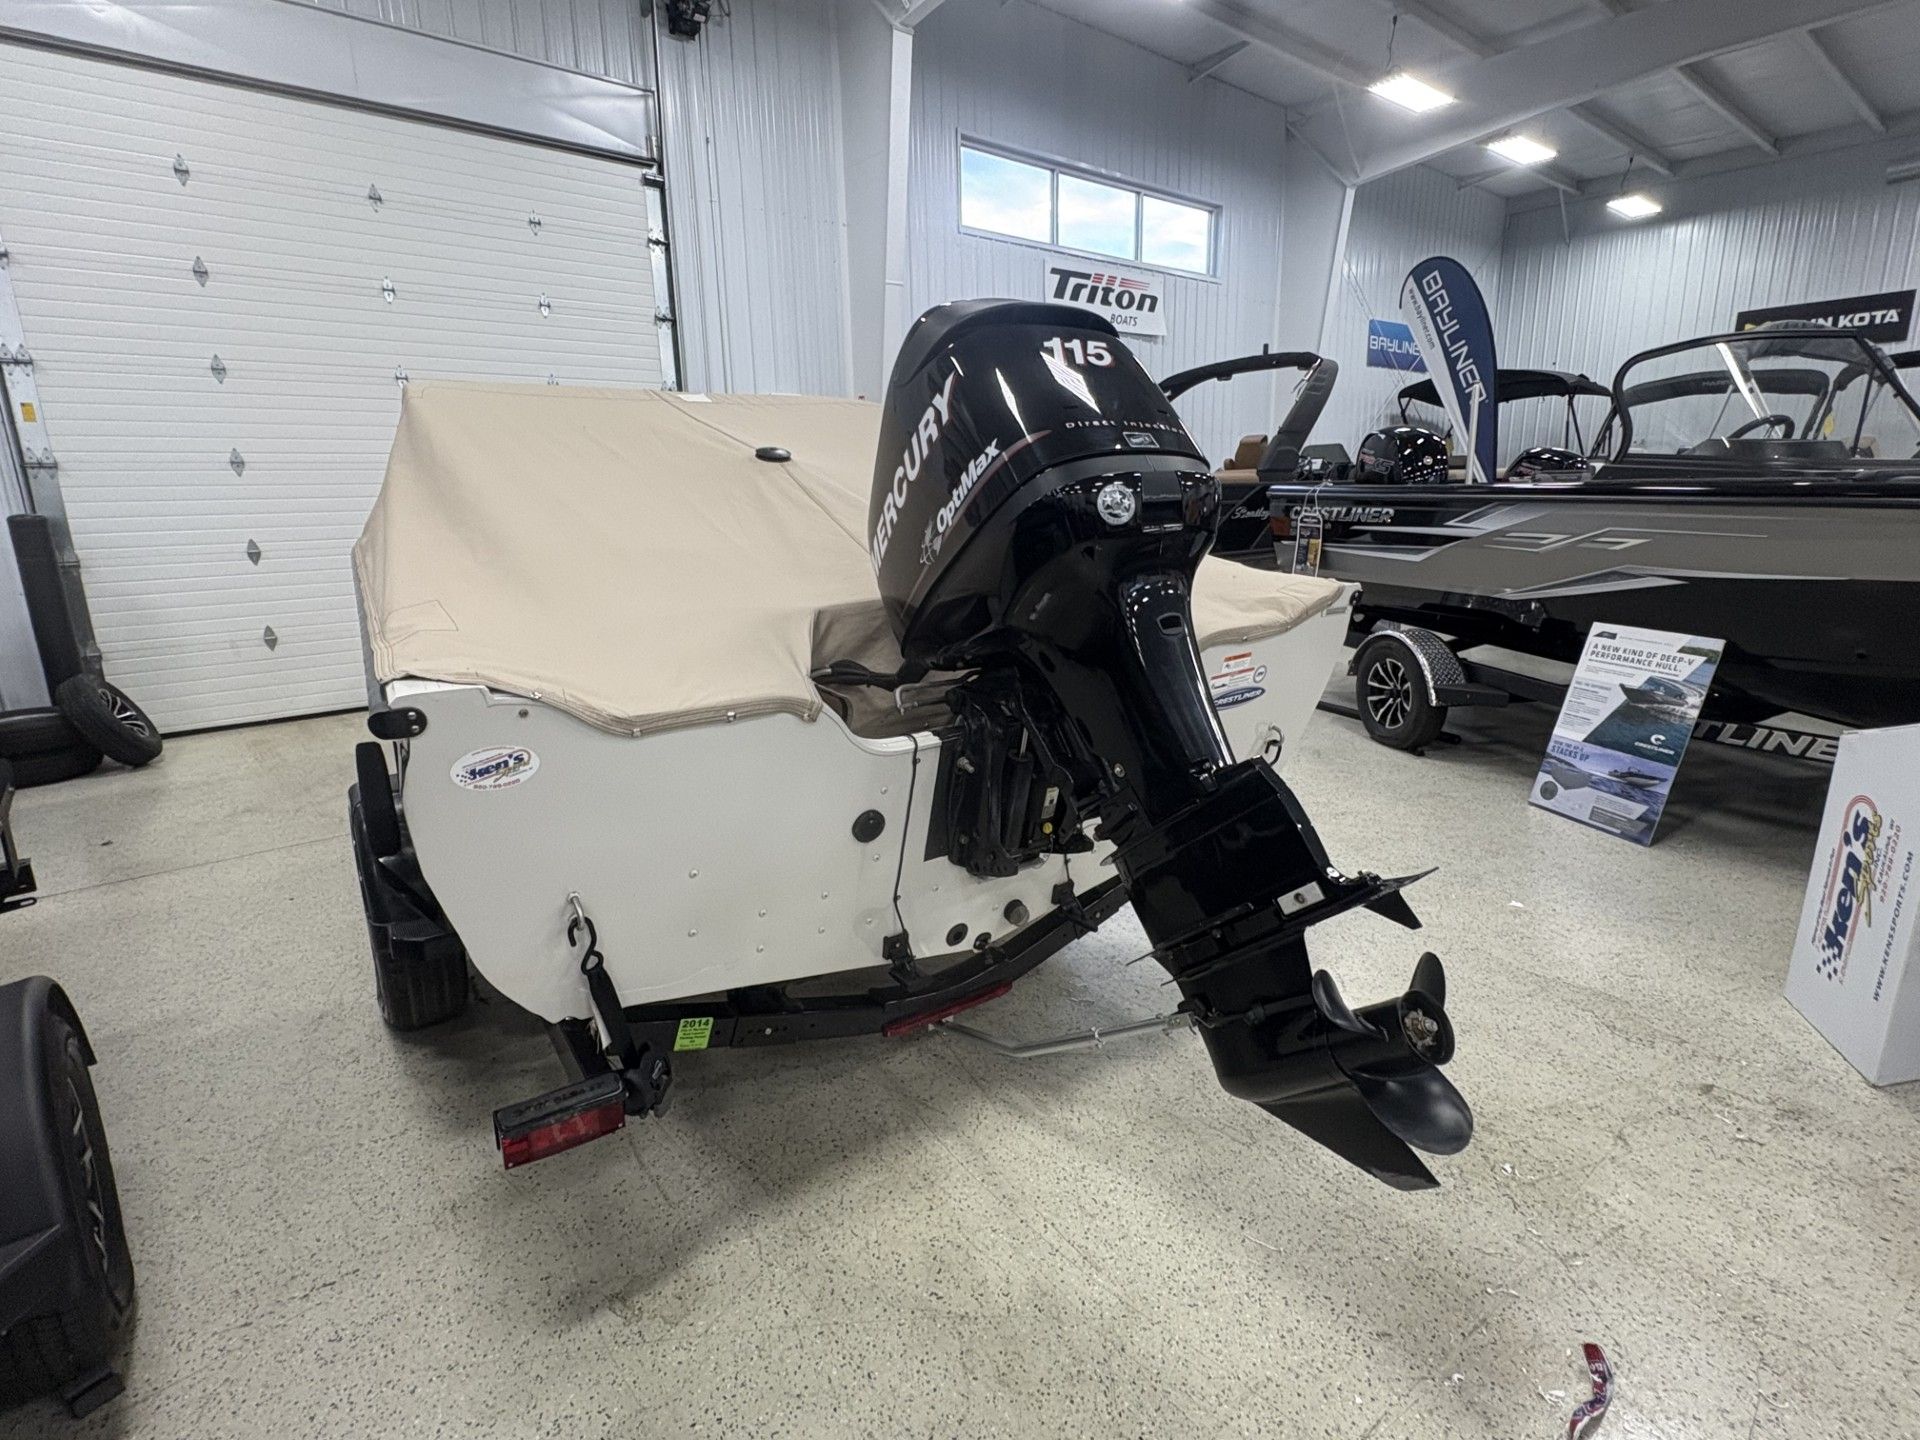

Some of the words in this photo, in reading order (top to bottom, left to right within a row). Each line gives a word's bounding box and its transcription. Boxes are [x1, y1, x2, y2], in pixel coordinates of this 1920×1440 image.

[1050, 267, 1159, 313] Triton
[1110, 313, 1138, 327] BOATS
[1838, 309, 1899, 328] KOTA
[1043, 337, 1114, 367] 115
[1369, 335, 1421, 356] BAYLINE
[870, 371, 956, 577] MERCURY
[1590, 650, 1653, 668] PERFORMANCE
[1601, 644, 1621, 653] NEW
[1622, 648, 1644, 657] KIND
[1646, 650, 1658, 660] OF
[1660, 654, 1695, 666] DEEP-V
[1551, 744, 1578, 759] STACKS
[1872, 850, 1914, 1003] WWW.KENSSPORTS.COM
[682, 1019, 710, 1028] 2014
